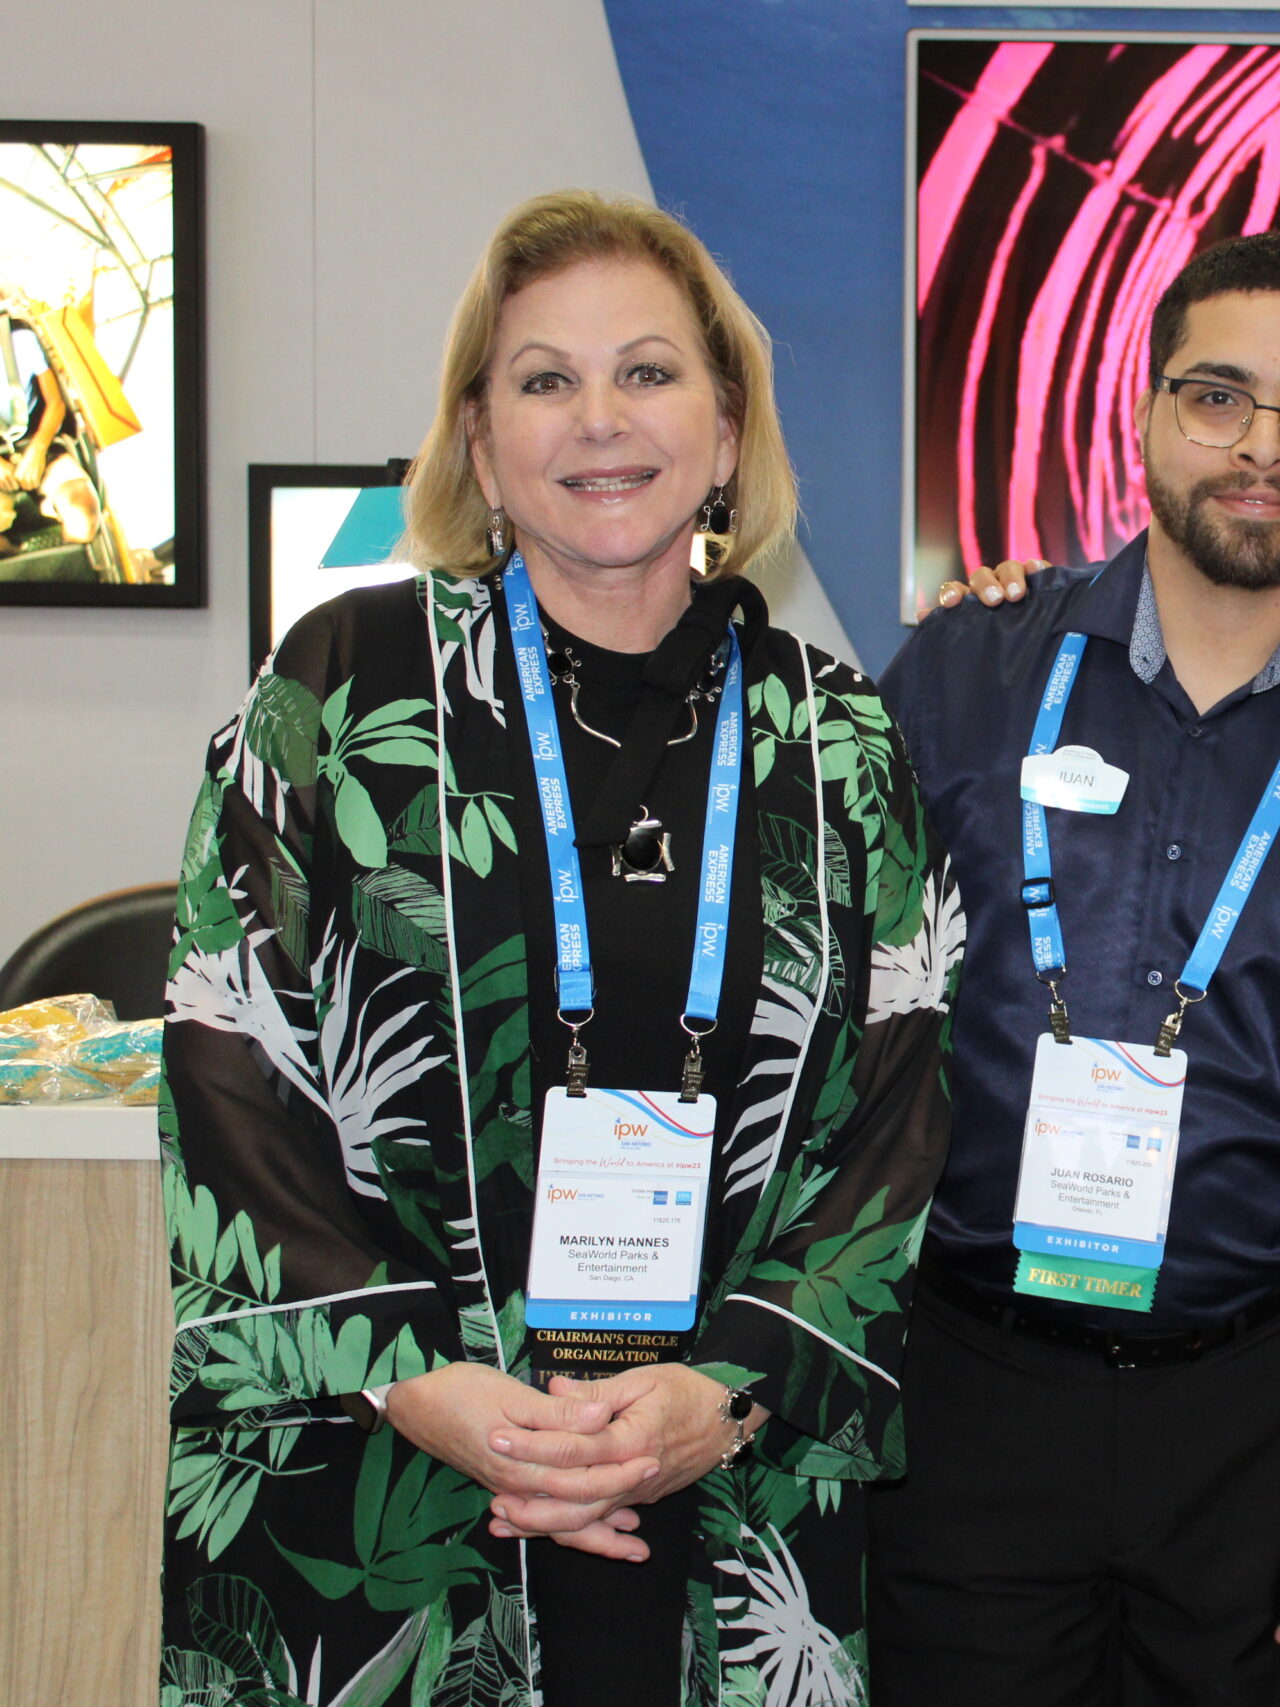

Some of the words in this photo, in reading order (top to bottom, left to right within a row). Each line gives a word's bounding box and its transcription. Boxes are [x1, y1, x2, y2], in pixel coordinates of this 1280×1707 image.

[511, 603, 535, 632] ipw
[517, 647, 536, 702] AMERICAN
[527, 646, 545, 695] EXPRESS
[1044, 653, 1068, 711] AMERICAN
[1054, 654, 1077, 704] EXPRESS
[533, 731, 558, 761] ipw
[717, 720, 730, 767] EXPRESS
[727, 711, 738, 767] AMERICAN
[540, 777, 558, 836] AMERICAN
[550, 778, 567, 829] EXPRESS
[712, 783, 737, 813] ipw
[1026, 802, 1036, 857] AMERICA
[1032, 803, 1044, 848] EXPRE
[705, 850, 719, 903] EXPRESS
[715, 844, 729, 904] AMERICAN
[1230, 834, 1260, 887] EXPRESS
[1239, 830, 1271, 891] AMERICAN
[554, 869, 579, 903] ipw
[1211, 905, 1238, 940] ipw
[560, 923, 572, 971] ERICAN
[700, 922, 726, 958] ipw
[1035, 937, 1045, 971] RICAN
[1043, 935, 1053, 968] RESS
[1091, 1062, 1122, 1083] ipw
[614, 1117, 648, 1140] ipw
[1035, 1119, 1061, 1136] ipw
[553, 1157, 584, 1166] Bringing
[585, 1158, 597, 1166] the
[636, 1160, 665, 1169] America
[1051, 1168, 1081, 1180] JUAN
[1083, 1171, 1134, 1188] ROSARIO
[548, 1184, 578, 1203] ipw
[1050, 1180, 1094, 1194] SeaWorld
[1096, 1186, 1121, 1198] Parks
[1123, 1191, 1130, 1199] &
[1058, 1193, 1120, 1209] Entertainment
[560, 1235, 614, 1246] MARILYN
[618, 1236, 670, 1248] HANNES
[568, 1250, 617, 1260] SeaWorld
[620, 1250, 649, 1260] Parks
[651, 1252, 659, 1260] &
[1047, 1236, 1121, 1253] EXHIBITOR
[577, 1263, 648, 1273] Entertainment
[1027, 1267, 1081, 1289] FIRST
[1084, 1275, 1143, 1298] TIMER
[570, 1311, 653, 1321] EXHIBITOR
[536, 1330, 625, 1345] CHAIRMAN'S
[627, 1334, 678, 1347] CIRCLE
[553, 1347, 660, 1362] ORGANIZATION
